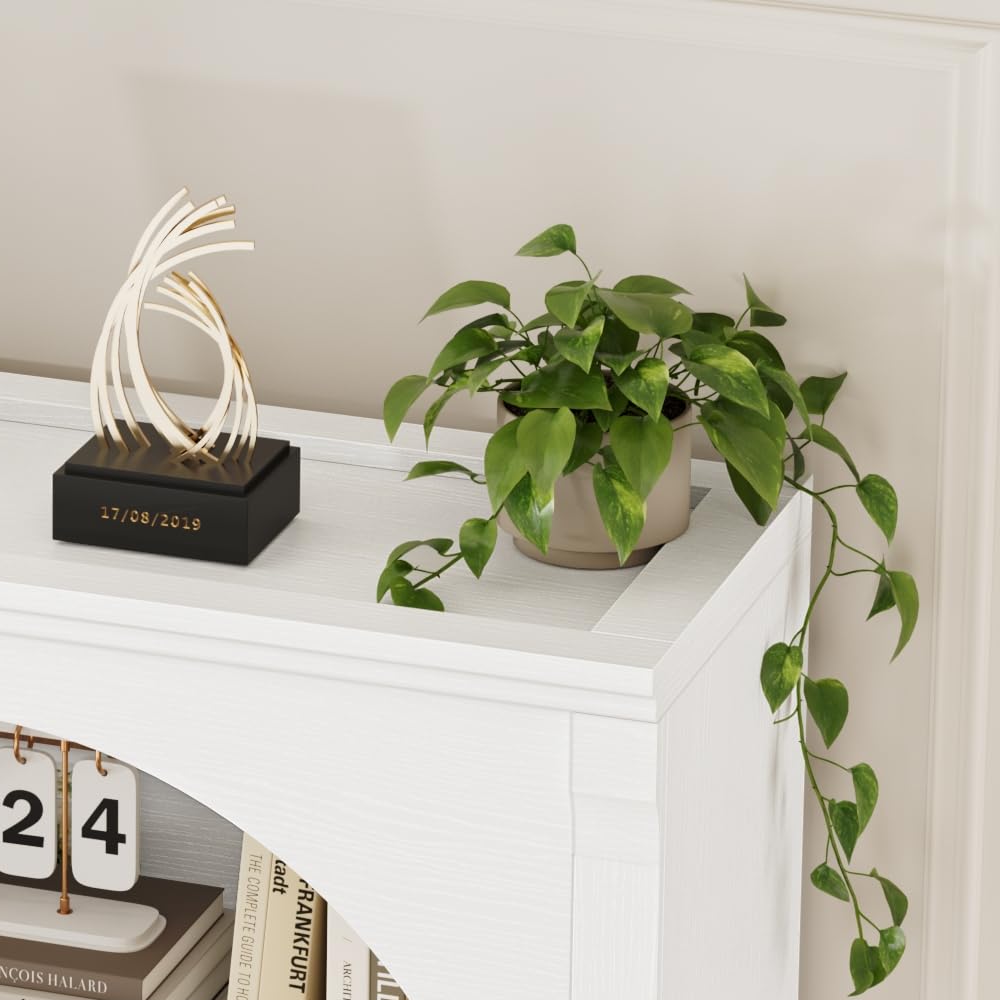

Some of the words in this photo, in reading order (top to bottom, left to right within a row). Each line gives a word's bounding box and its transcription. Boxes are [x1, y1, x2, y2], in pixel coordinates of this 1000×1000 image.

[100, 506, 201, 531] 17/08/2019
[2, 789, 45, 848] 2
[81, 797, 126, 856] 4
[248, 854, 263, 873] THE
[242, 878, 261, 936] COMPLETE
[239, 935, 255, 969] GUIDE
[47, 972, 108, 995] HALARD
[238, 972, 251, 988] TO
